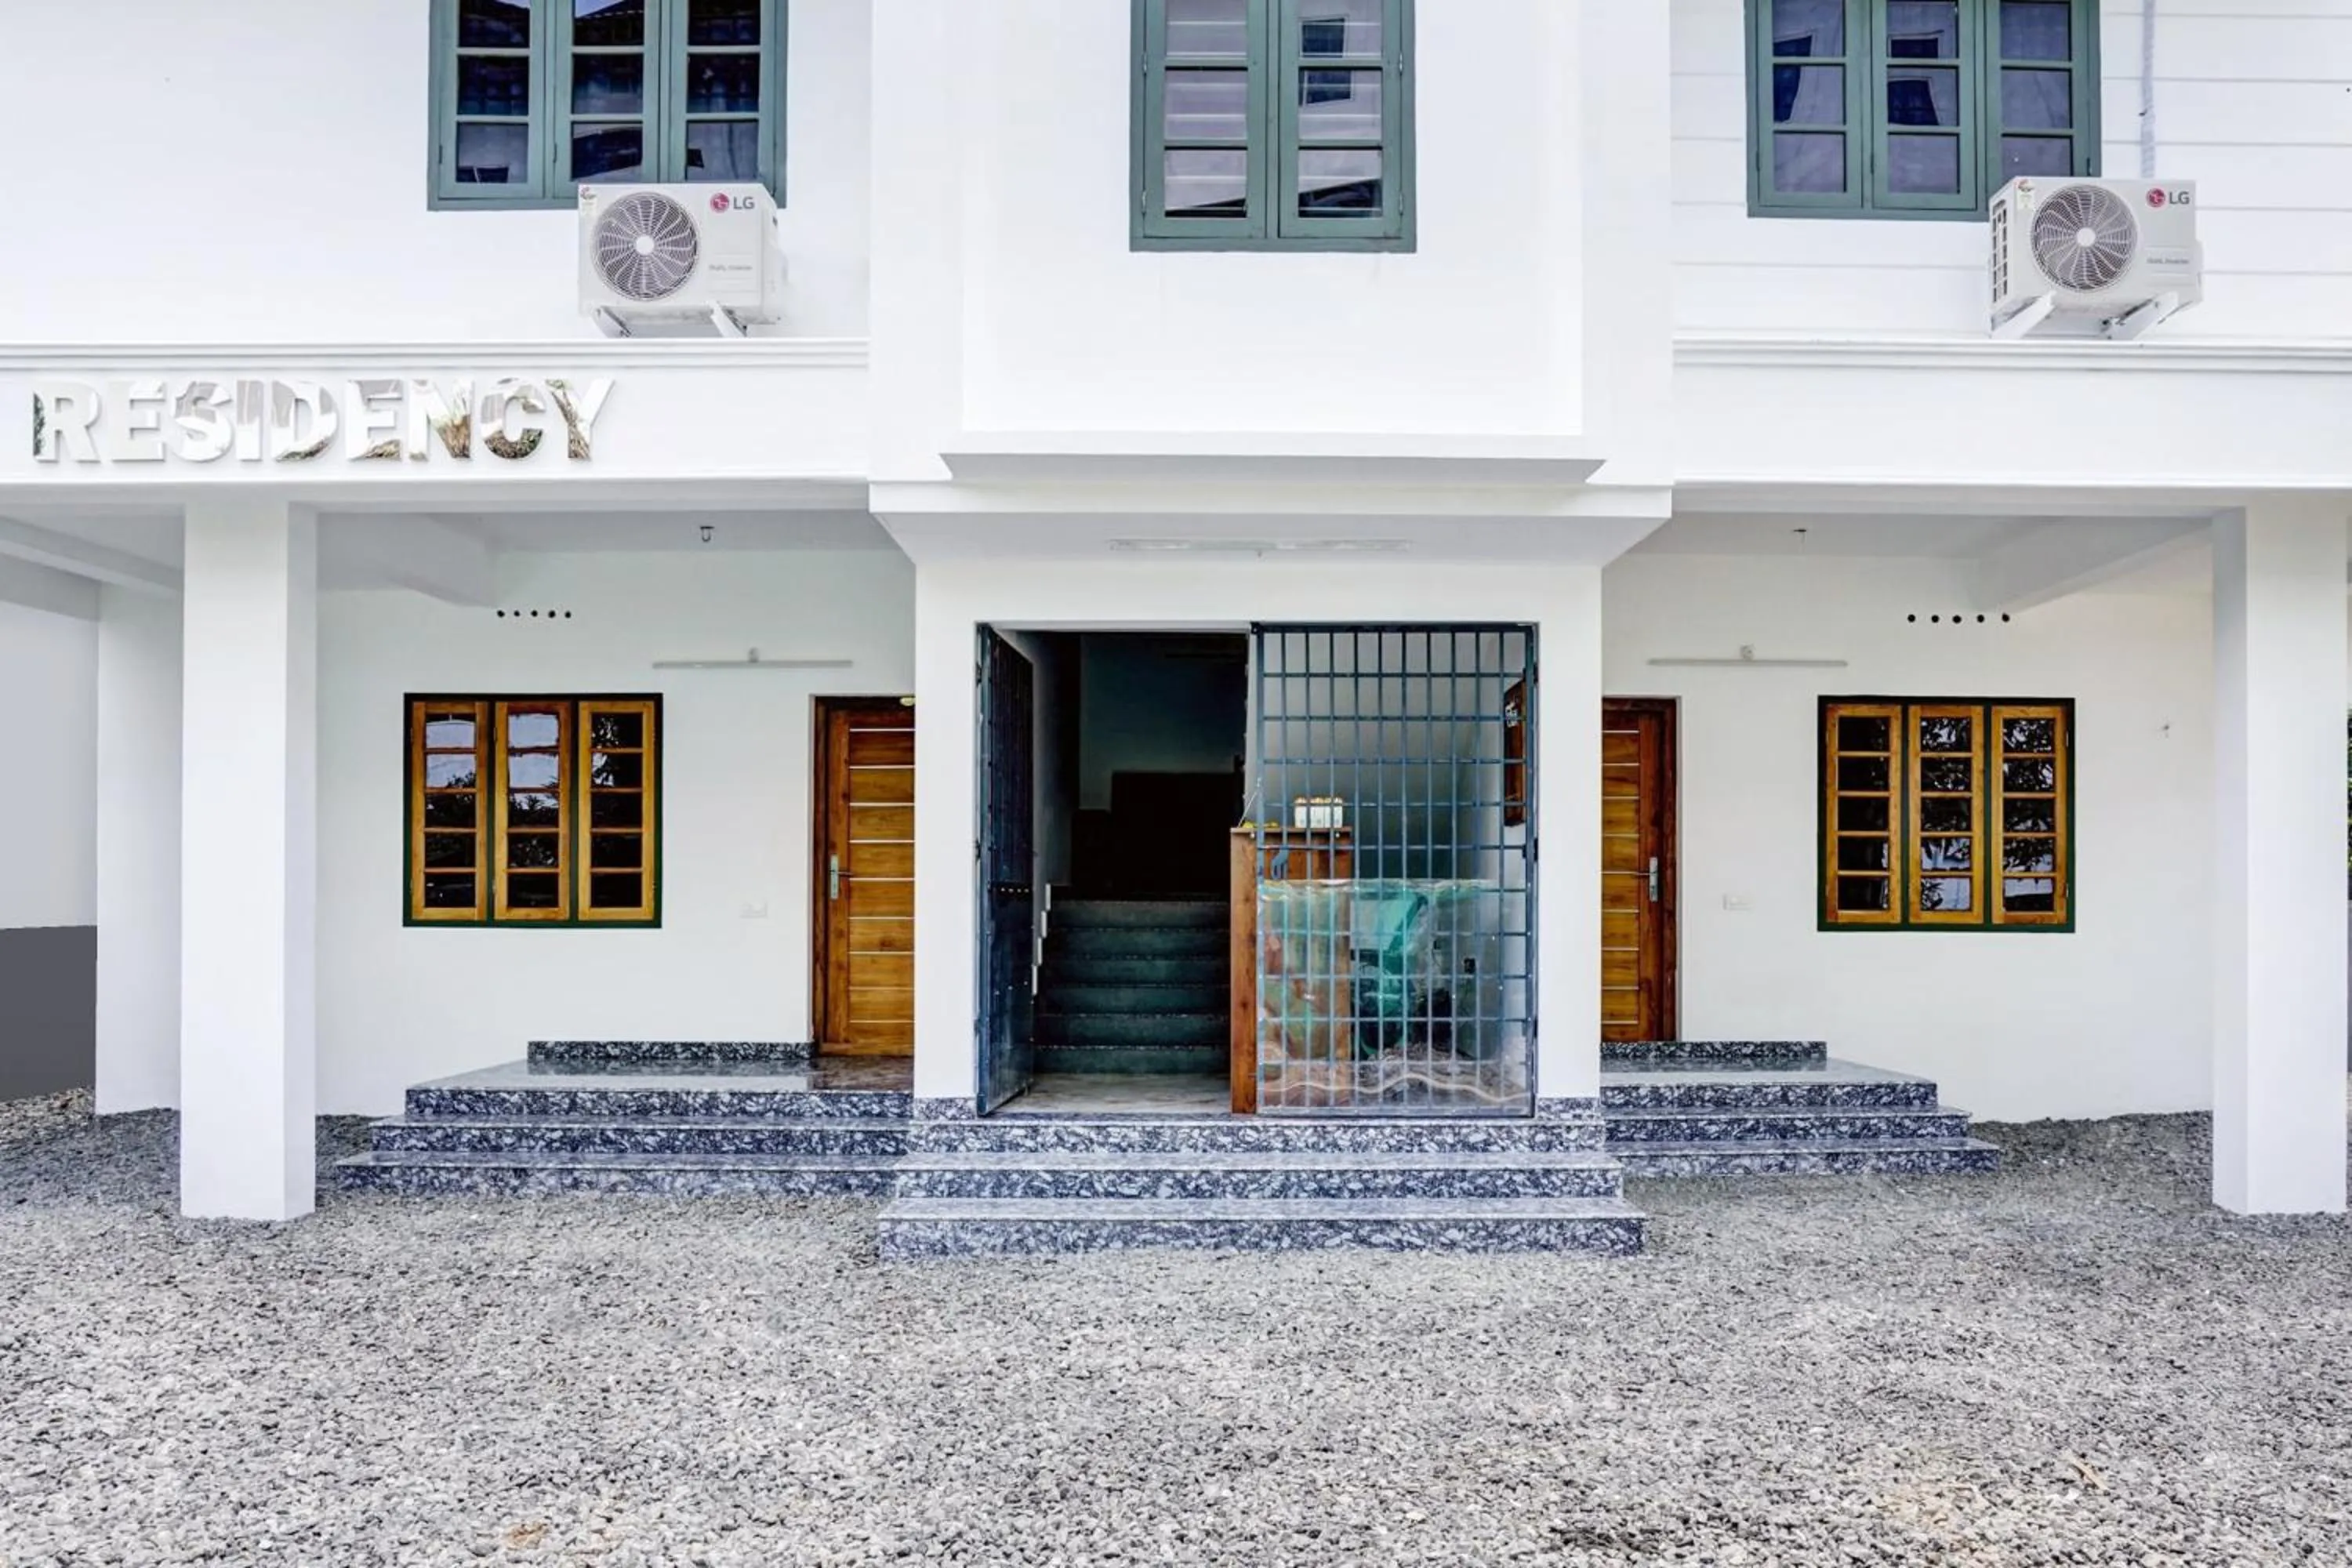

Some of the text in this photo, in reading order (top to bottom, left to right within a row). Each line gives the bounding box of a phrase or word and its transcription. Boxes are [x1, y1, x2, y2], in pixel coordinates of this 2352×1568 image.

[733, 196, 755, 209] LG
[2169, 191, 2190, 205] LG
[32, 377, 616, 464] RESIDENCY
